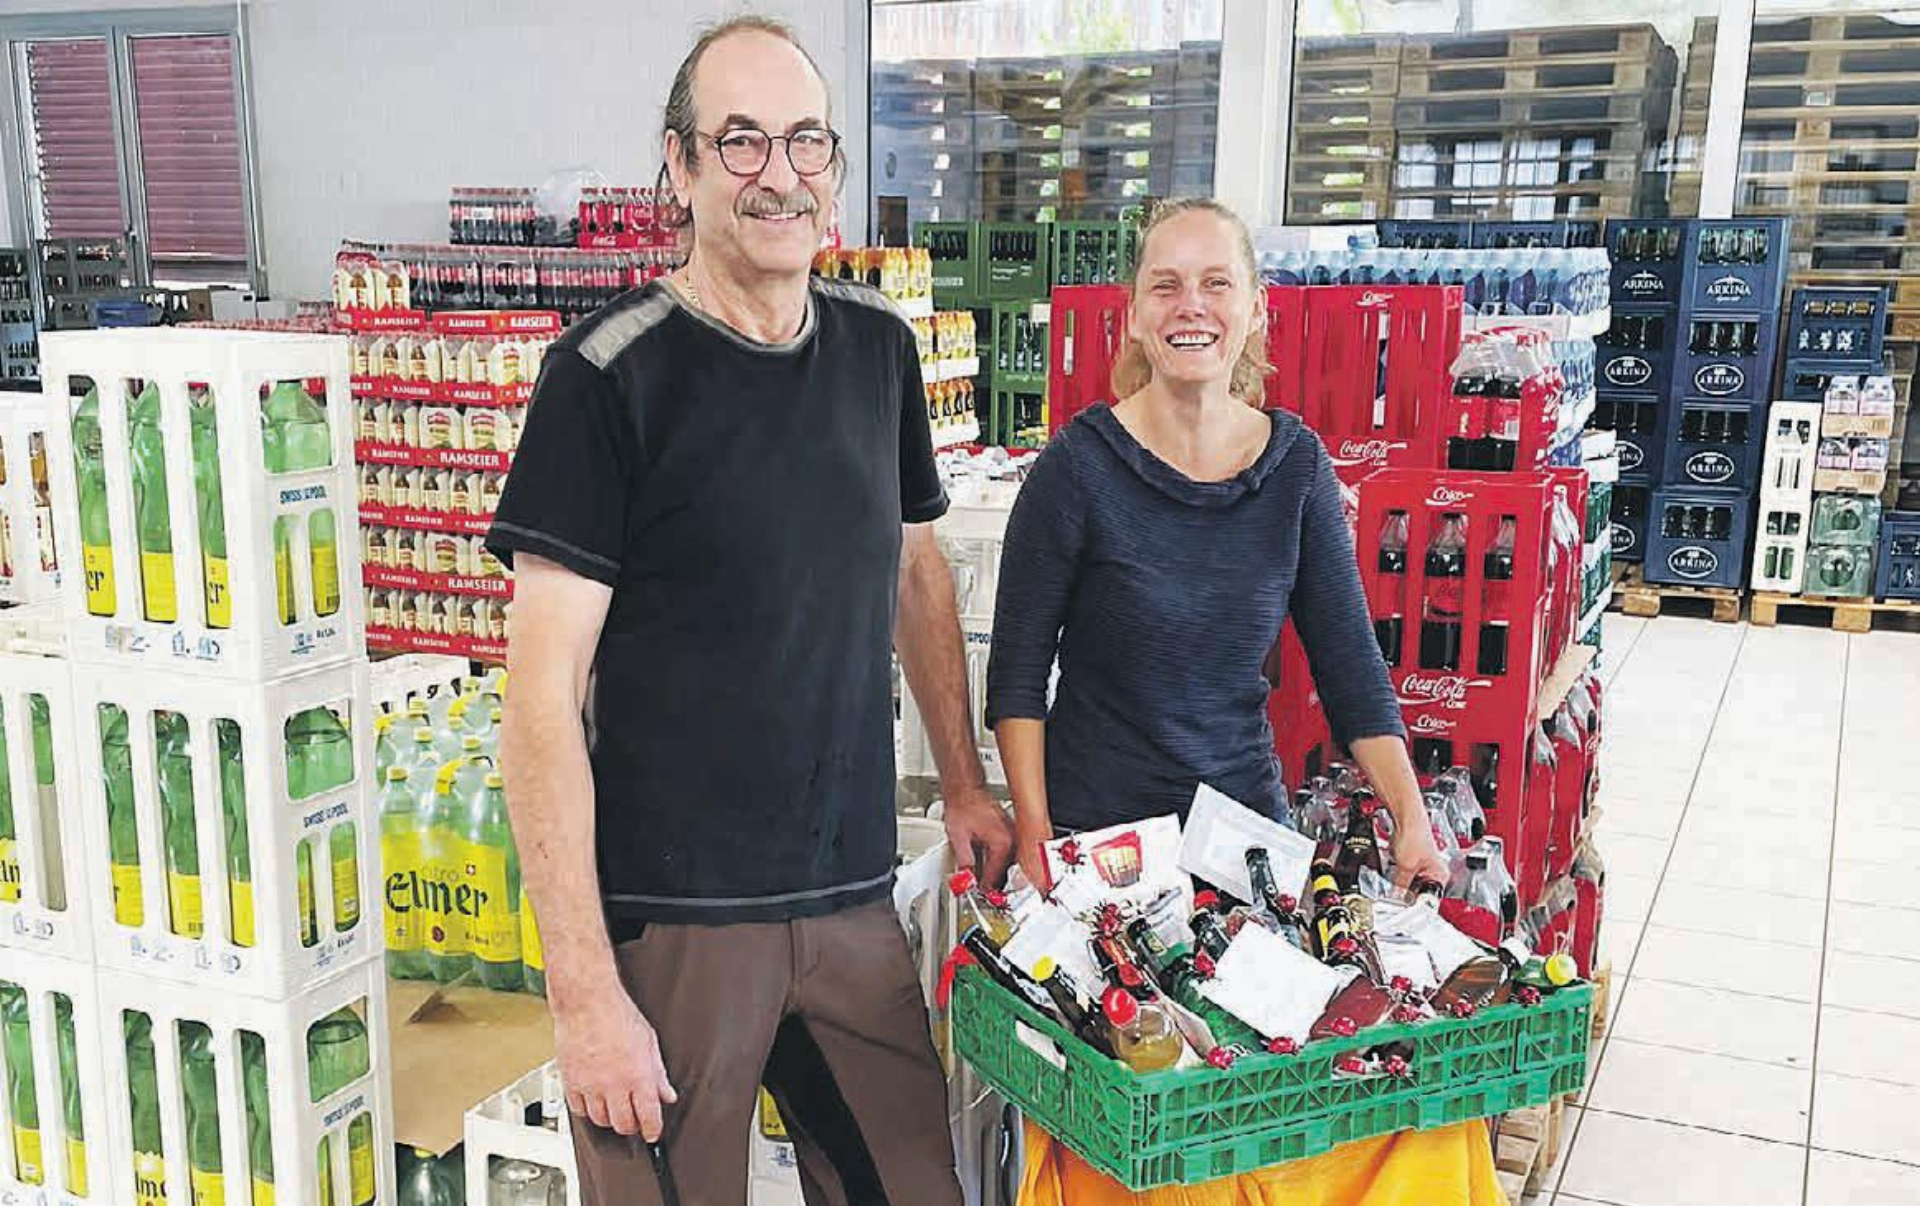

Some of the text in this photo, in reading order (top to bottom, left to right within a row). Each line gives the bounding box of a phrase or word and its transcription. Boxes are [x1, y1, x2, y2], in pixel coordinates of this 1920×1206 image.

[1622, 279, 1664, 290] ARKINA
[1705, 284, 1752, 296] ARKINA
[510, 315, 554, 328] RAMSEIER
[1609, 367, 1647, 376] ARKINA
[1699, 373, 1739, 384] ARKINA
[439, 451, 500, 467] RAMSEIER
[1690, 464, 1731, 473] ARKINA
[1672, 558, 1714, 570] ARKINA
[448, 577, 507, 592] RAMSEIER
[385, 870, 489, 918] Elmer
